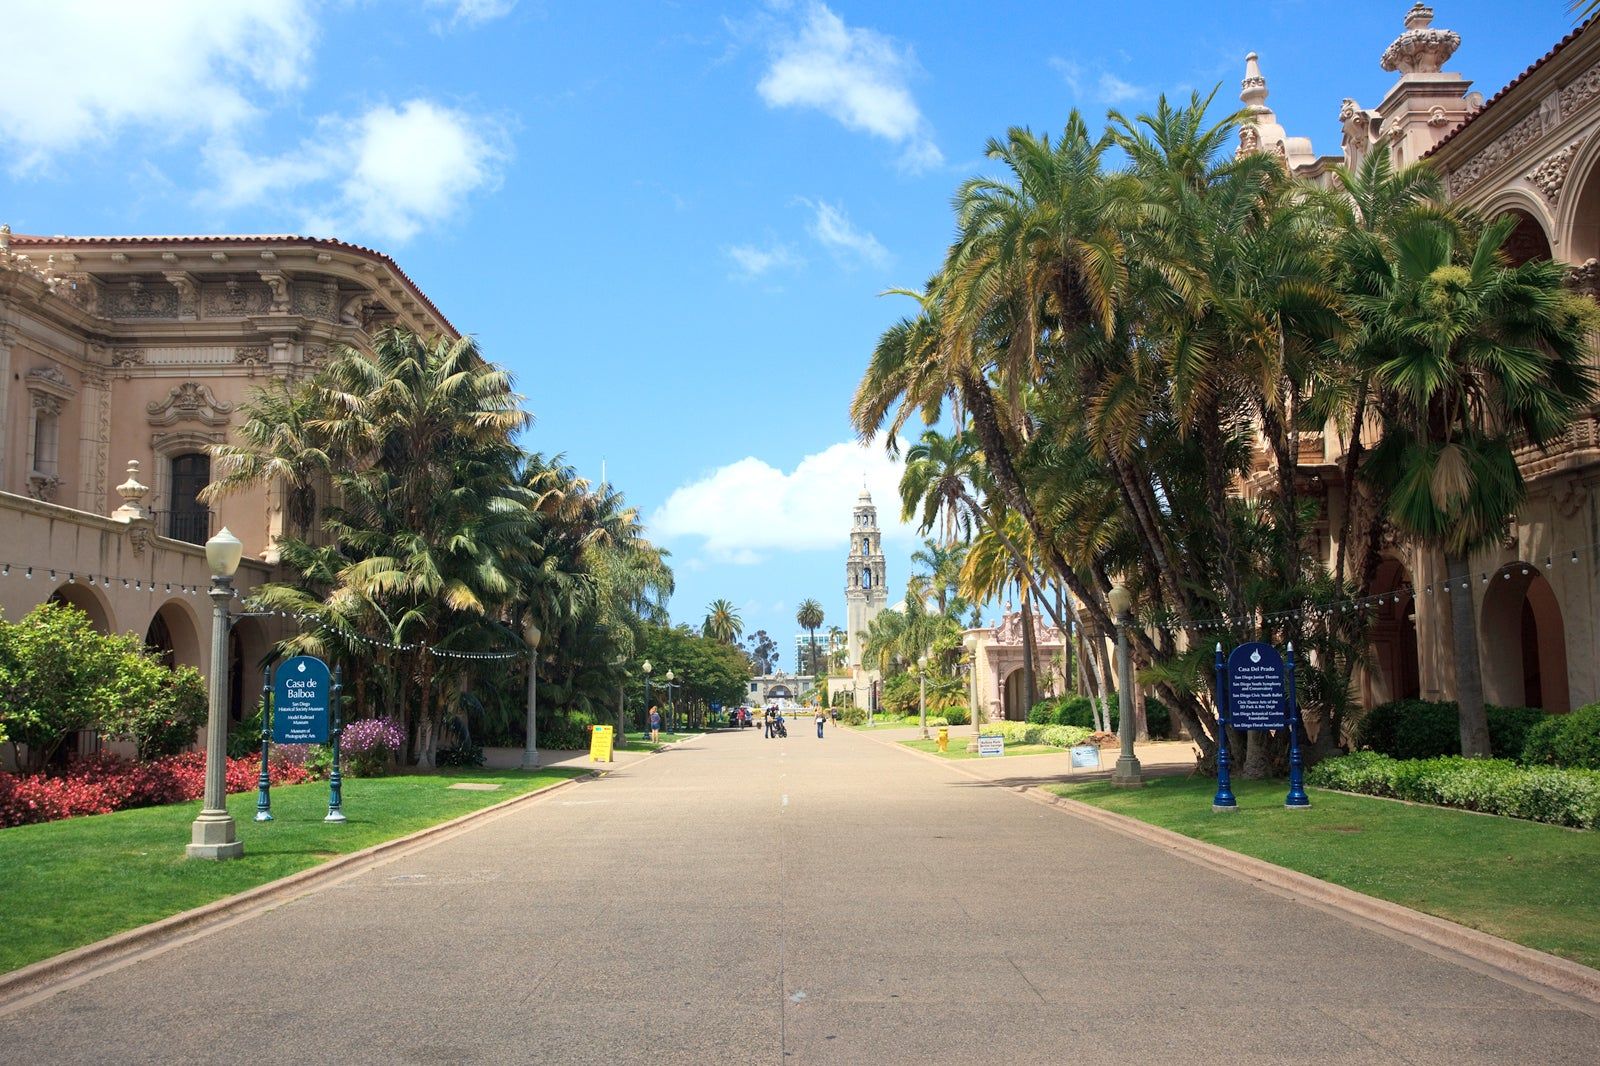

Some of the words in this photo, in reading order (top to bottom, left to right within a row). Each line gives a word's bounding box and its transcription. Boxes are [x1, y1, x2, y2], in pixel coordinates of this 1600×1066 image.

[286, 679, 305, 688] Casa
[306, 678, 317, 688] de
[288, 689, 315, 698] Balboa
